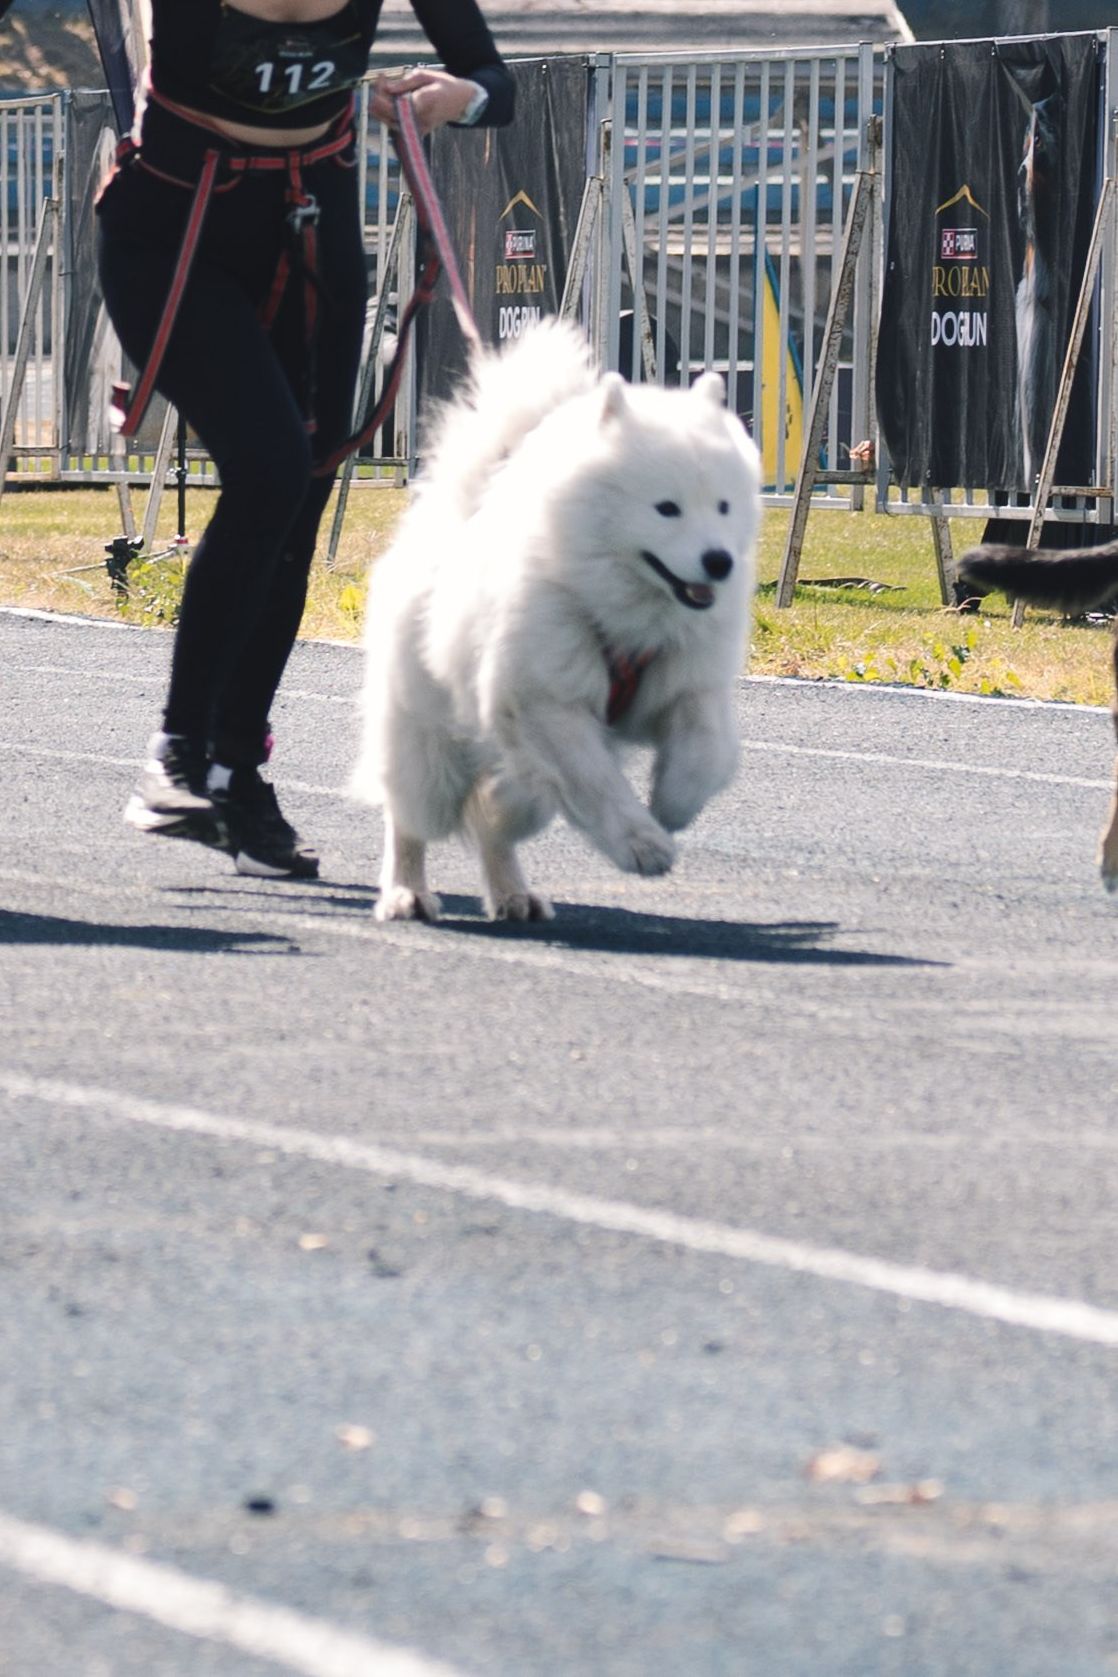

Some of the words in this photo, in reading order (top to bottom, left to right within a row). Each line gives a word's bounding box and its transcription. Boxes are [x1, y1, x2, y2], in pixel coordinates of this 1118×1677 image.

[254, 60, 335, 94] 112
[496, 265, 517, 294] PRO
[932, 266, 961, 296] RO
[499, 306, 521, 339] DOG
